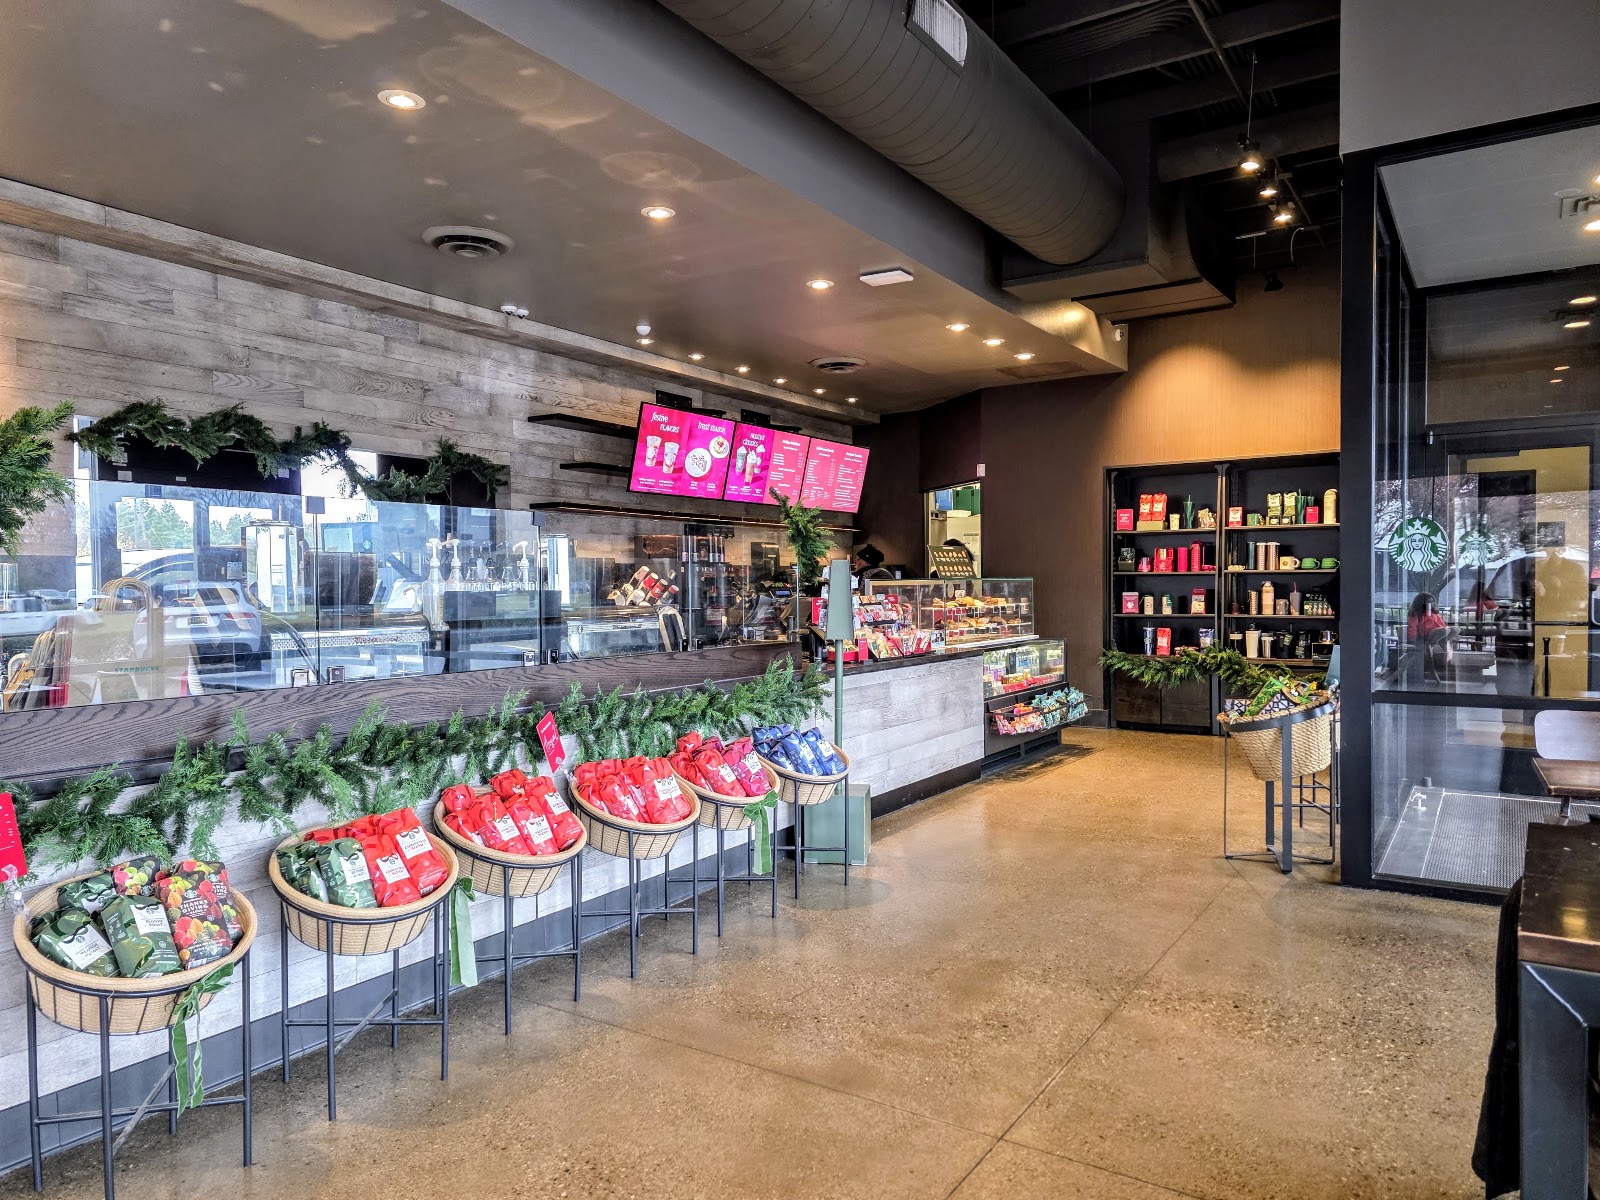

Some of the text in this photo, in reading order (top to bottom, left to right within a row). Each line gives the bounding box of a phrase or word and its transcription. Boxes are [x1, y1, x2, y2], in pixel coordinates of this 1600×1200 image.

[650, 411, 669, 423] festive
[659, 423, 680, 434] FLAVORS
[179, 899, 209, 910] THANKS
[181, 904, 209, 914] GIVING
